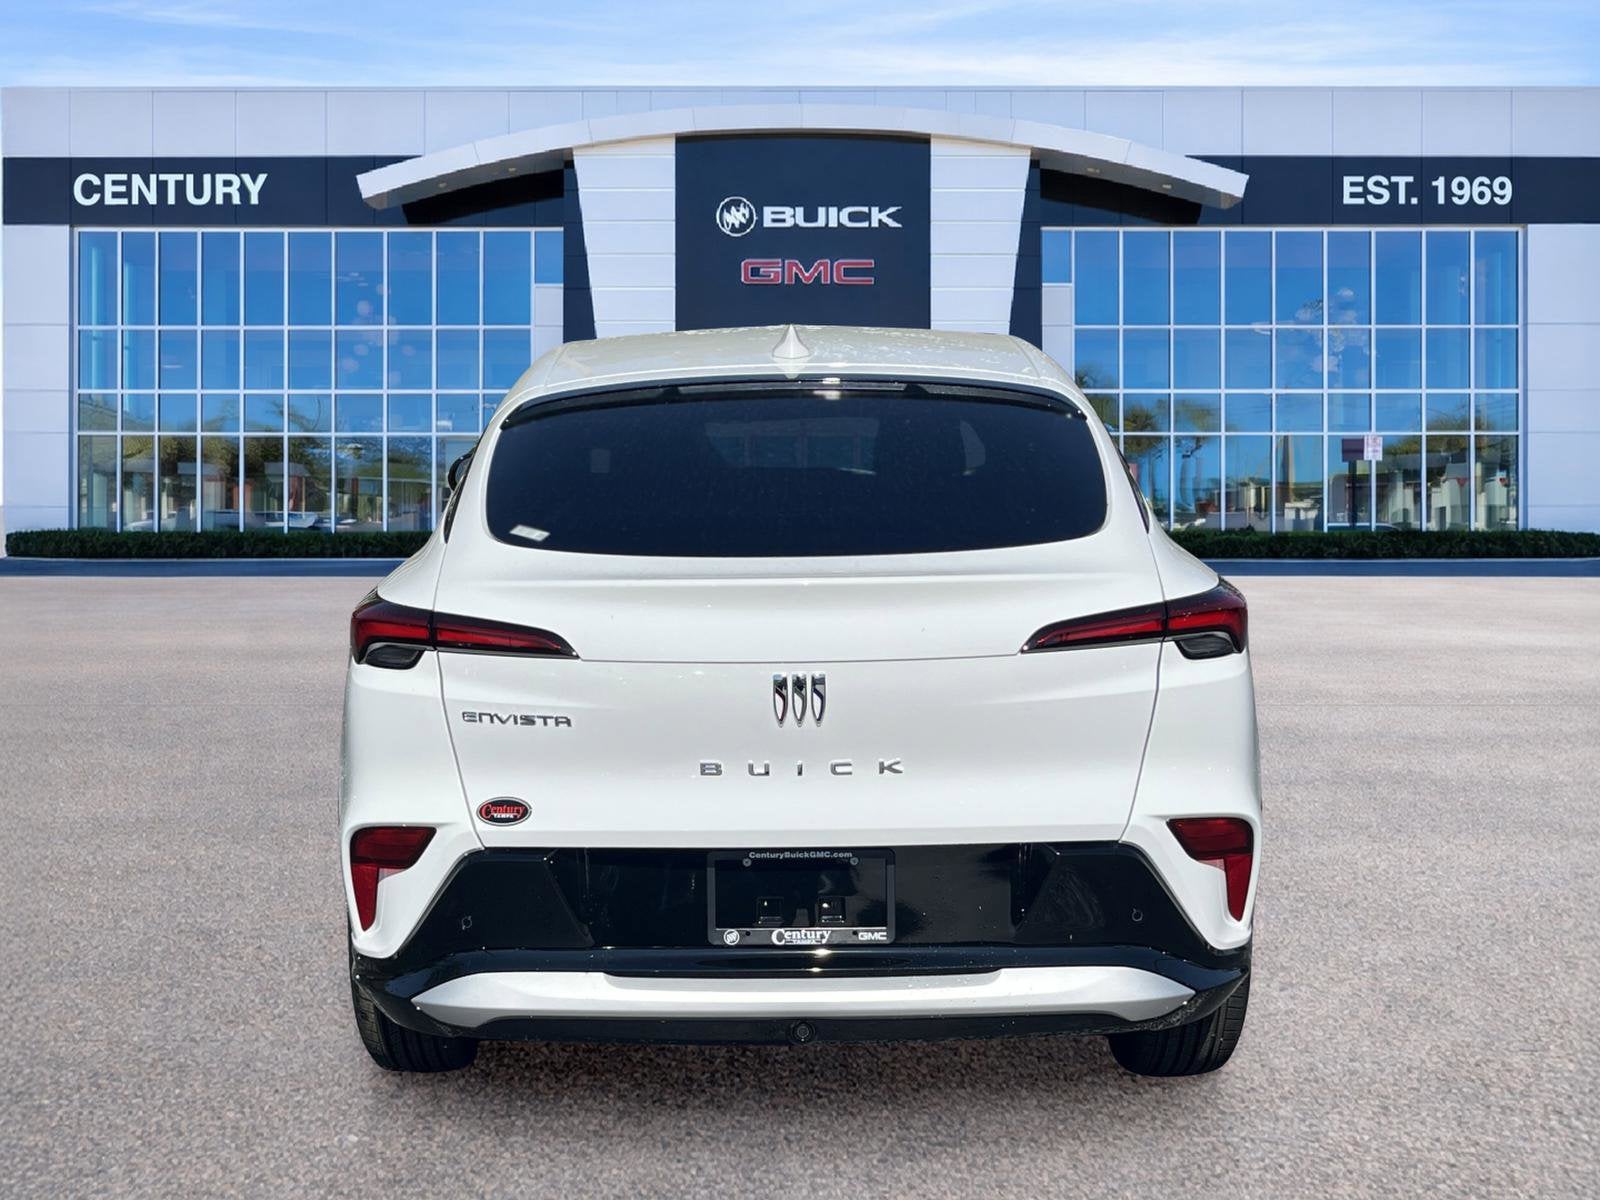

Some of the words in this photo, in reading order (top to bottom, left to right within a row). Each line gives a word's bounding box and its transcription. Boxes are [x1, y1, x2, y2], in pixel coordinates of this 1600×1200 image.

[73, 173, 268, 206] CENTURY
[1342, 175, 1419, 205] EST.
[1431, 175, 1513, 206] 1969
[762, 206, 903, 228] BUICK
[741, 258, 875, 285] GMC
[462, 711, 572, 727] ENVISTA
[700, 759, 904, 776] BUICK
[481, 804, 525, 819] Century
[749, 851, 852, 859] CenturyBuickGMC.com
[771, 928, 831, 945] Century
[858, 931, 887, 941] GMC
